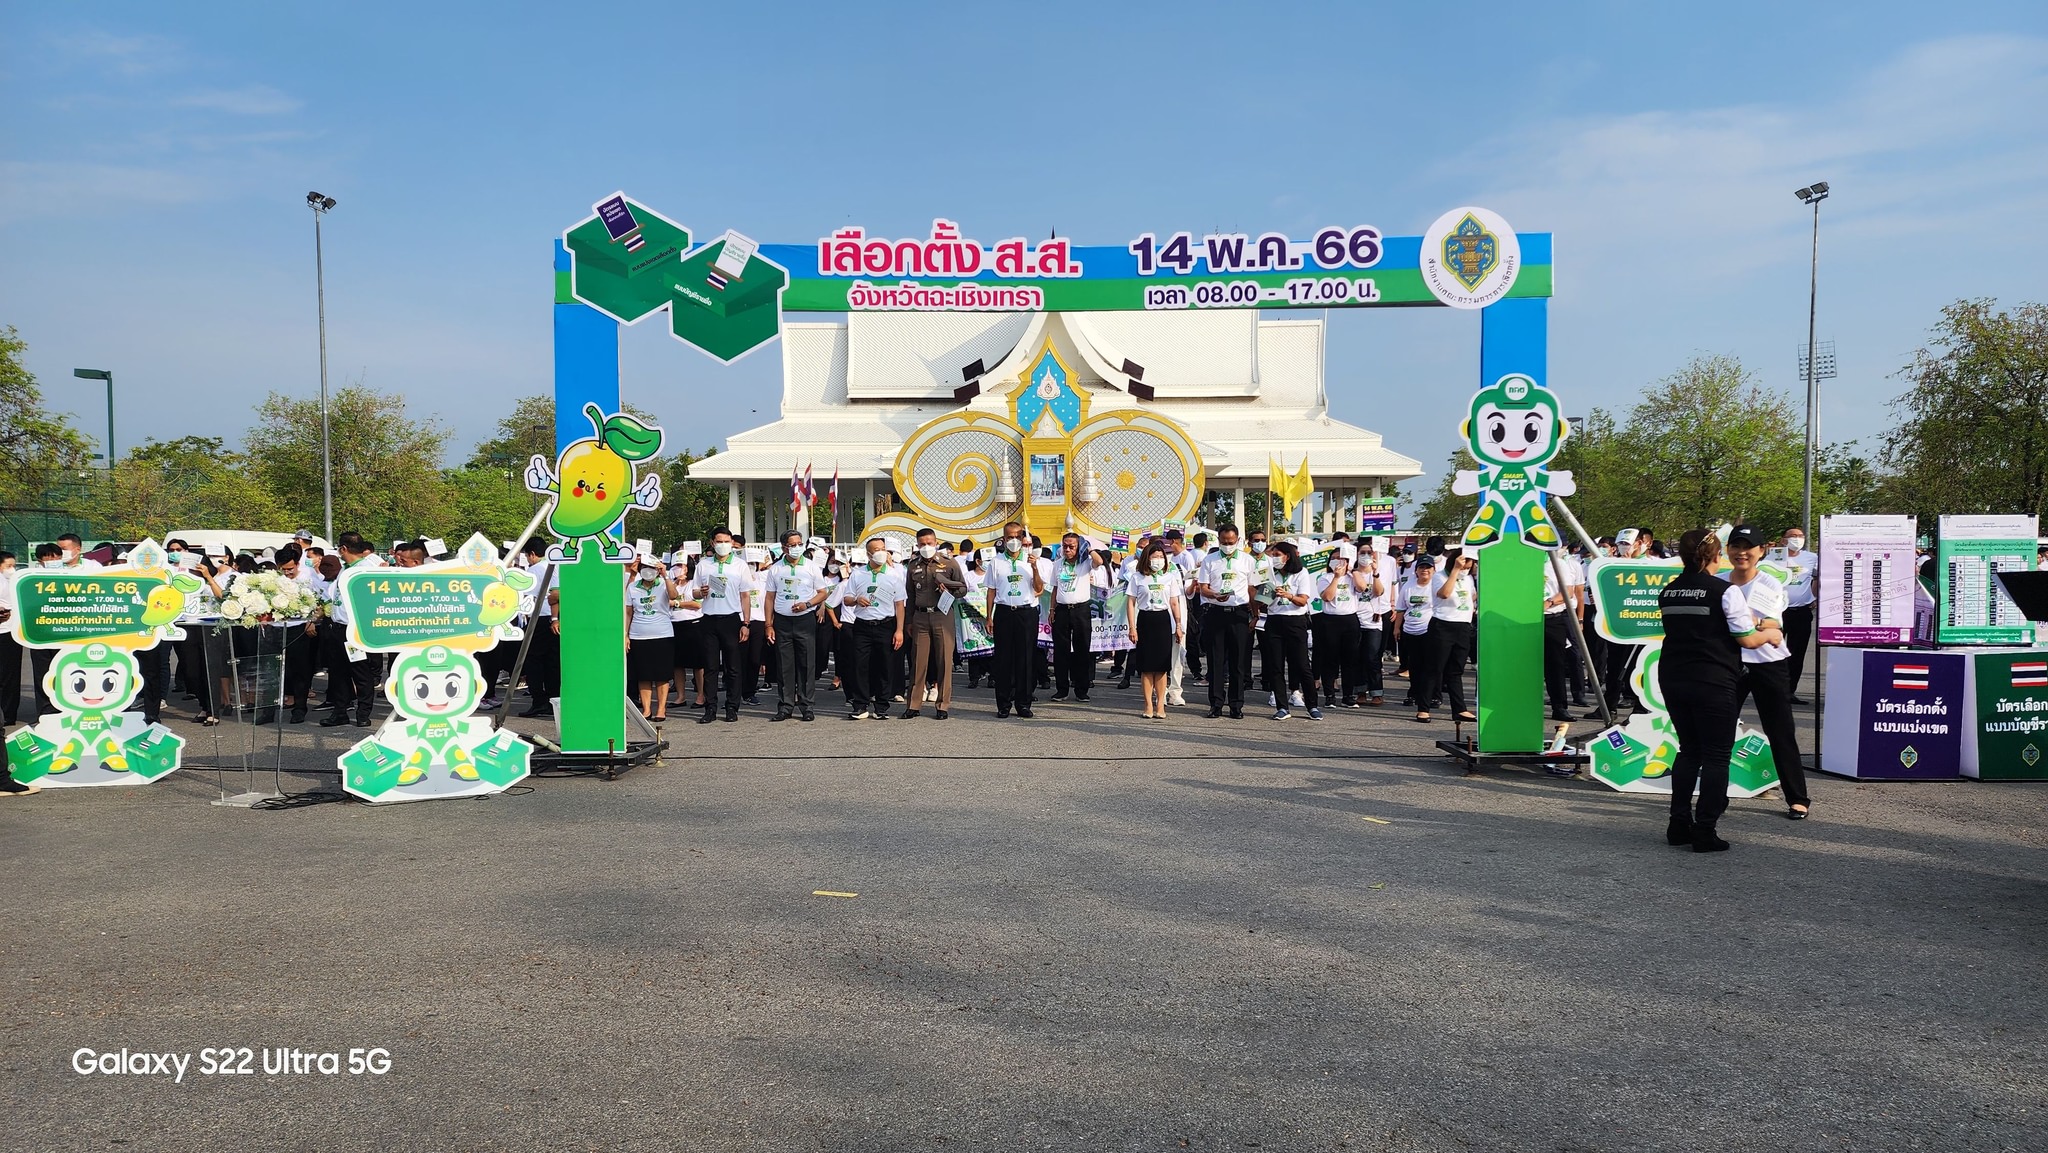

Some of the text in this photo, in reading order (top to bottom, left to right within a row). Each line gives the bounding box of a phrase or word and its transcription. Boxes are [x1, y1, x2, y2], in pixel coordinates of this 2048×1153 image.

[822, 222, 1079, 273] เลือกตั้ง ส.ส.
[1132, 229, 1379, 271] 14 พ.ค. 66
[851, 284, 1041, 307] จังหวัดฉะเชิงเทรา
[1148, 289, 1187, 306] เวลา
[1196, 285, 1257, 303] 08.00
[1287, 281, 1348, 300] 17.00
[1358, 283, 1377, 298] น.
[1498, 479, 1527, 491] ECT
[1615, 572, 1680, 586] 14 พ.
[34, 581, 138, 595] 14 พ.ค. 66
[367, 579, 472, 594] 14 พ.ค. 66
[115, 616, 134, 625] ส.ส.
[453, 617, 472, 625] ส.ส.
[1092, 624, 1128, 632] .00-17.00
[1875, 696, 1948, 715] บัตรเลือกตั้ง
[1995, 697, 2048, 713] บัตรเลือก
[79, 721, 104, 730] ECT
[1873, 719, 1949, 734] แบบแบ่งเขต
[425, 728, 450, 738] ECT
